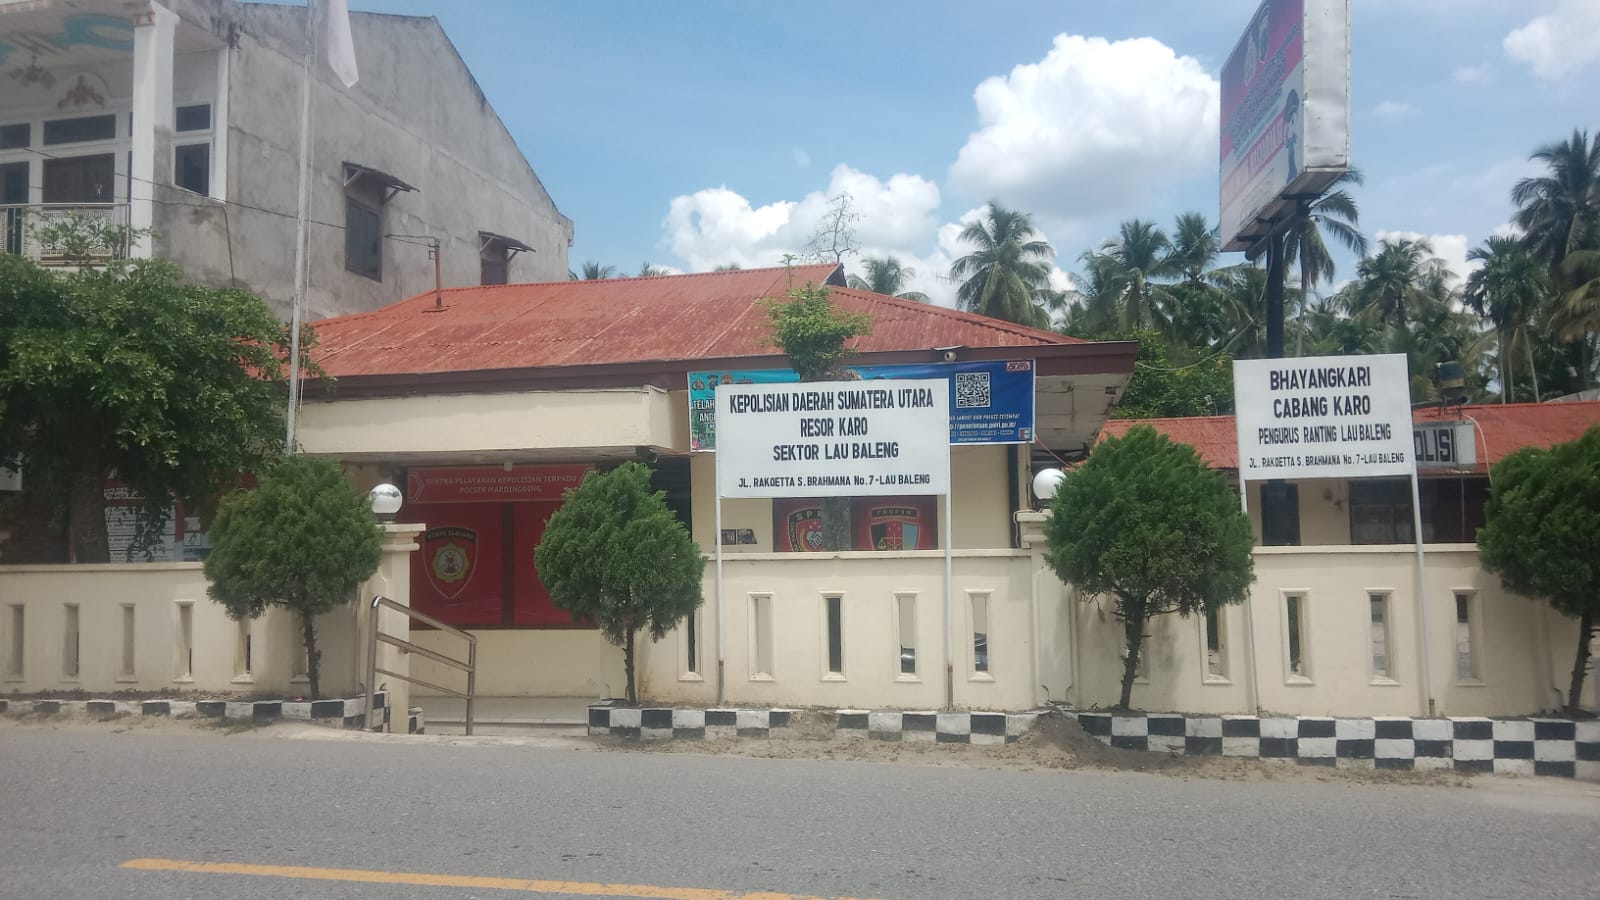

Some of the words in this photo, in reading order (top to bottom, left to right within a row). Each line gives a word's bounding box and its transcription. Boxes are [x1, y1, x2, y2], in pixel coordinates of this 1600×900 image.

[1270, 366, 1371, 391] BHAYANGKARI
[729, 393, 789, 413] KEPOLISIAN
[792, 391, 834, 412] DAERAH
[837, 389, 894, 410] SUMATERA
[898, 388, 934, 408] UTARA
[1273, 397, 1328, 418] CABANG
[1333, 395, 1371, 416] KARO
[800, 418, 834, 438] RESOR
[838, 417, 868, 437] KARO
[1258, 427, 1299, 445] PENGURUS
[1303, 426, 1337, 442] RANTING
[1341, 425, 1358, 441] LAU
[1360, 424, 1391, 440] BALENG
[773, 444, 819, 461] SEKTOR
[825, 443, 849, 460] LAU
[852, 442, 899, 459] BALENG
[1414, 429, 1455, 463] OLISI
[1249, 457, 1260, 469] JL.
[1262, 456, 1295, 468] RAKOETTA
[1378, 452, 1405, 464] BALENG
[543, 474, 577, 482] TERPADU
[738, 478, 752, 488] JL.
[753, 477, 795, 488] RAKOETTA
[898, 474, 930, 485] BALENG
